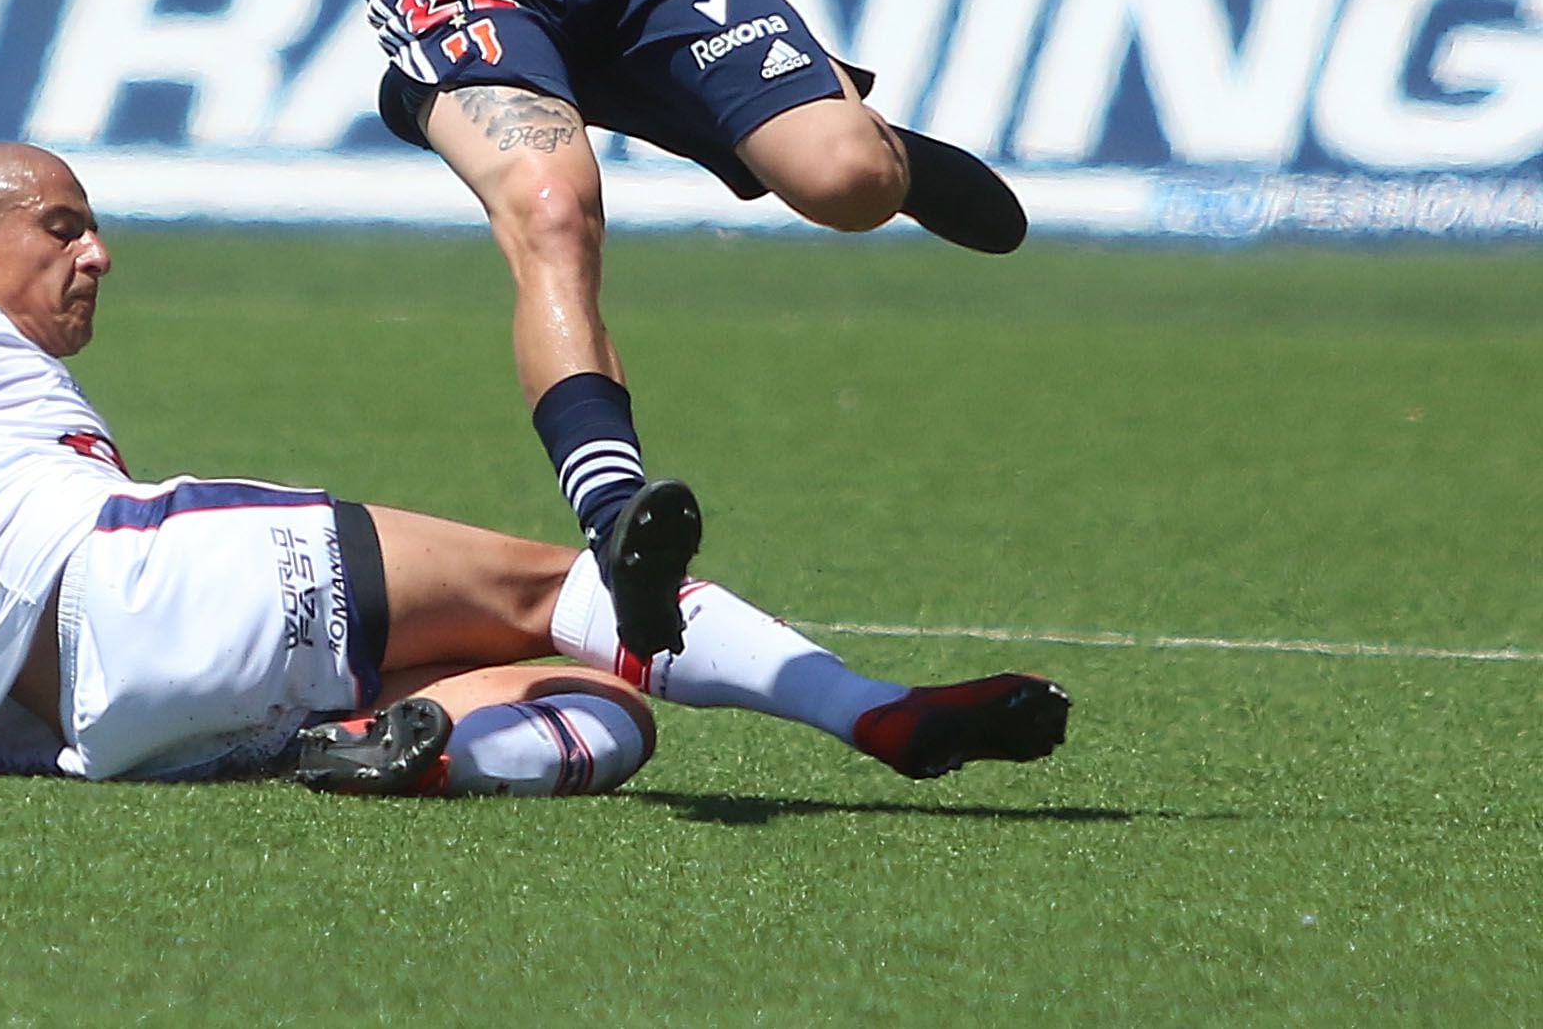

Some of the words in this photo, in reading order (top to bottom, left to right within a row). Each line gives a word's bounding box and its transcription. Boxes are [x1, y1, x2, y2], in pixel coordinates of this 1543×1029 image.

[690, 14, 789, 70] Rexona
[270, 527, 298, 651] WORLD
[294, 528, 316, 648] FAST
